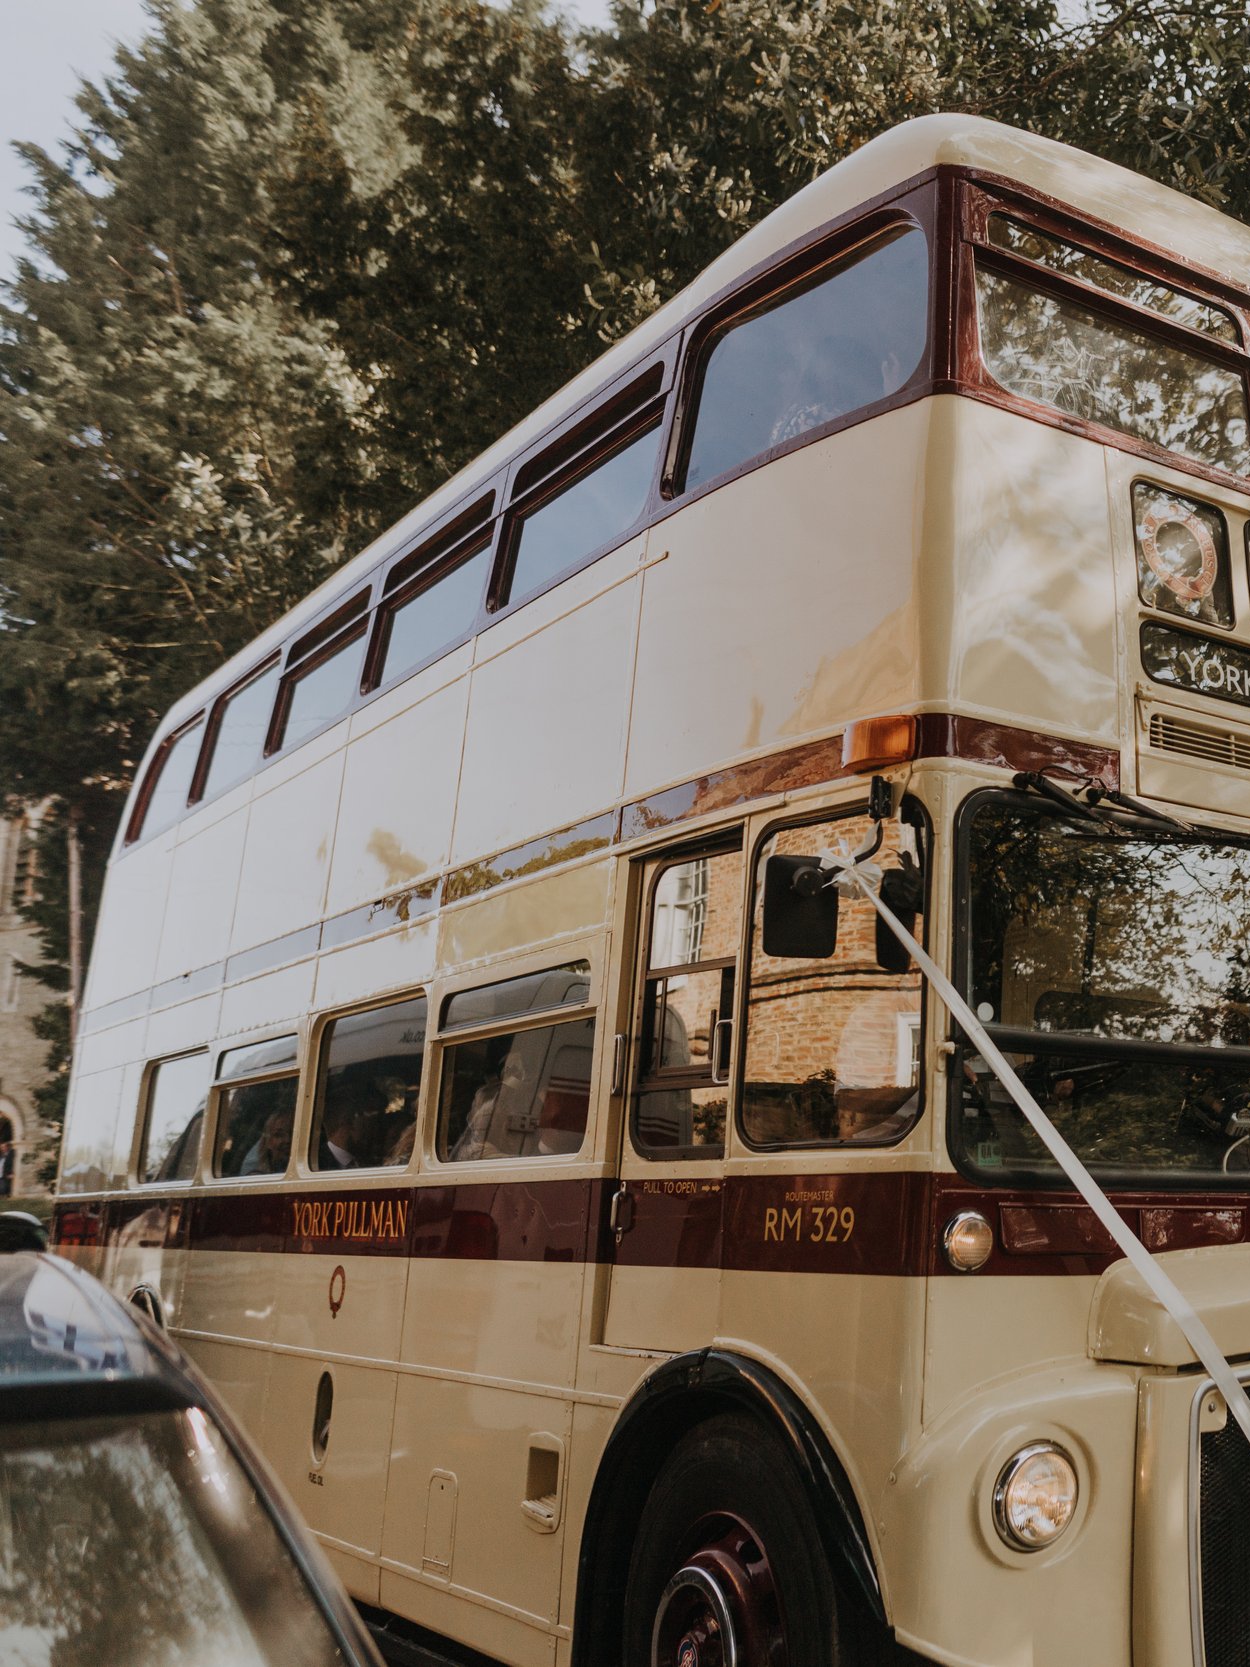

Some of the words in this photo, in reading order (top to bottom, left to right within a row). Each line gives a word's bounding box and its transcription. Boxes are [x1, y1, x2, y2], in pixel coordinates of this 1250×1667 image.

[643, 1182, 661, 1194] PULL
[663, 1181, 674, 1194] TO
[675, 1181, 698, 1194] OPEN
[785, 1191, 834, 1202] ROUTEMASTER
[293, 1201, 333, 1237] YORK
[333, 1200, 408, 1238] PULLMAN
[764, 1207, 802, 1242] RM
[810, 1206, 855, 1243] 329
